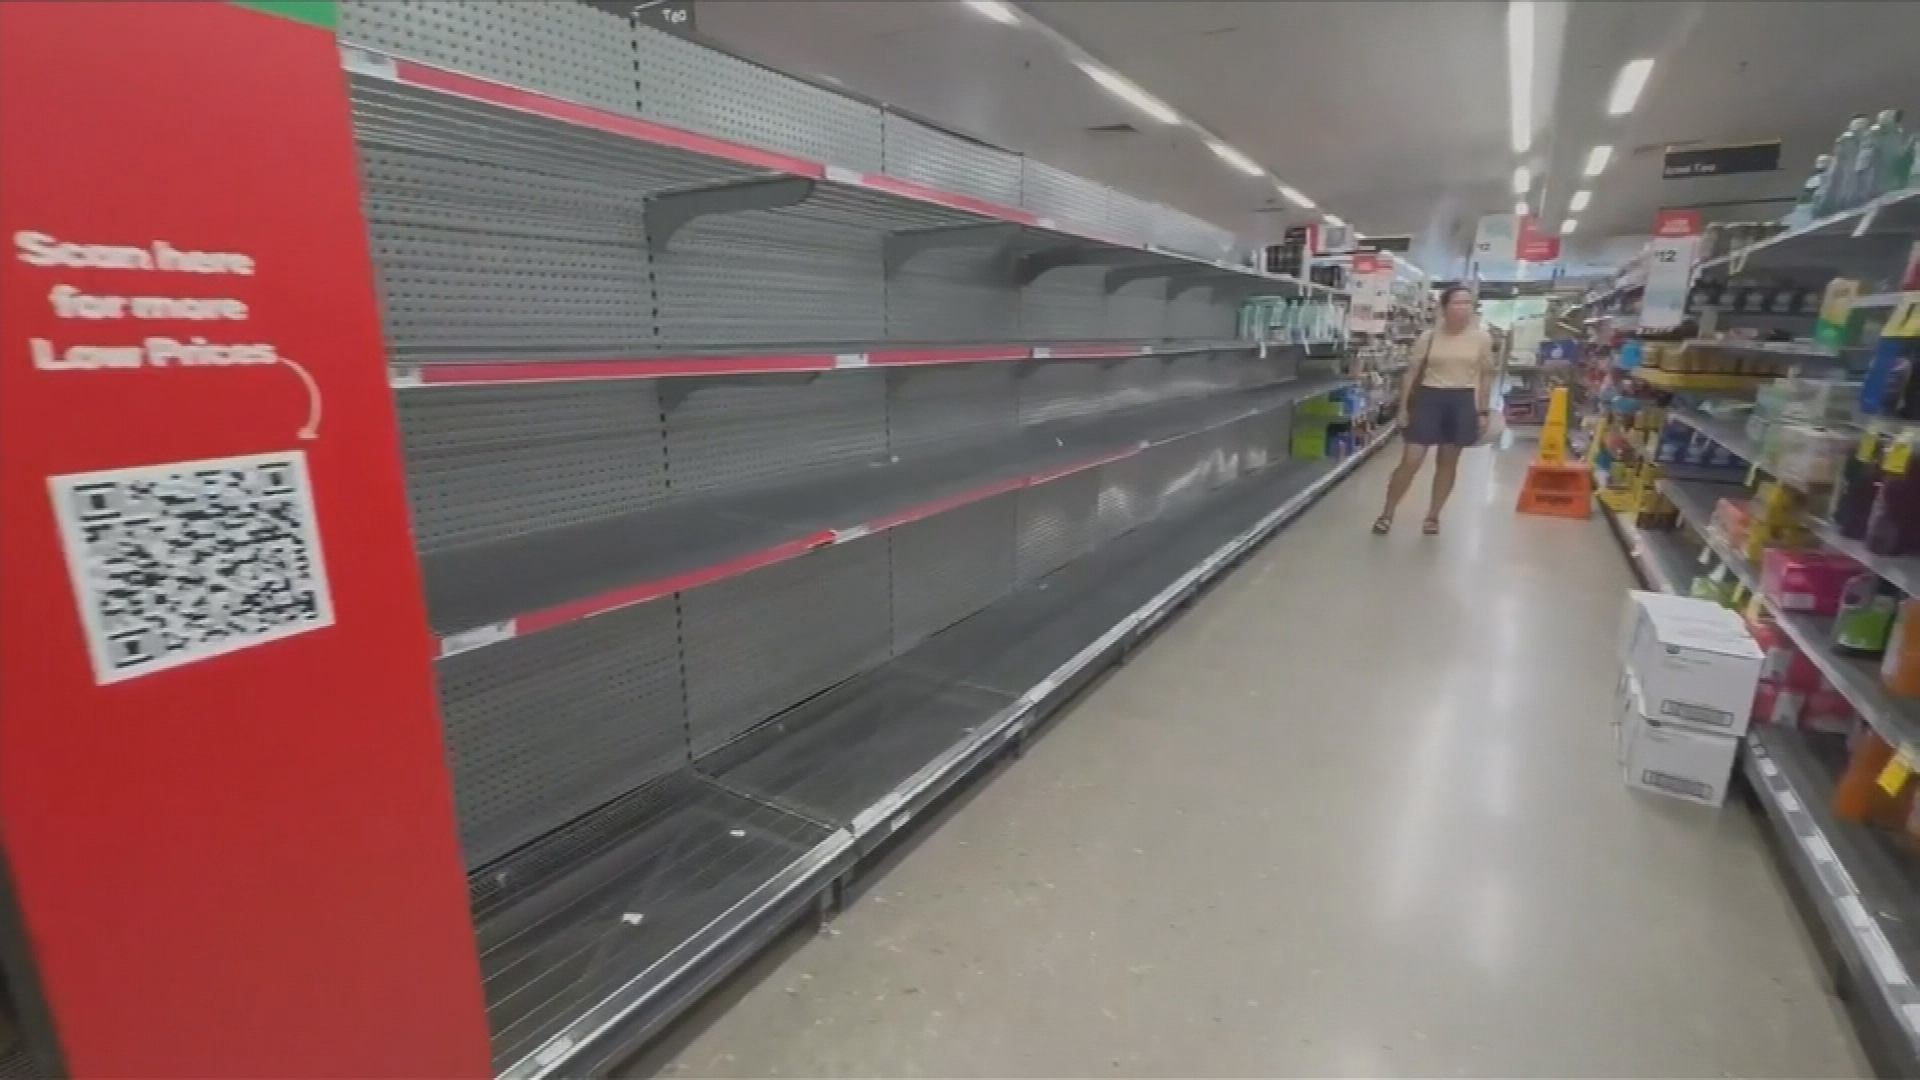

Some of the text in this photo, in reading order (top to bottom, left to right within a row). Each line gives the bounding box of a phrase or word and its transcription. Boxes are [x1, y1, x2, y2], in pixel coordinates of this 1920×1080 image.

[14, 230, 255, 275] Scan here
[48, 283, 249, 320] for more
[29, 337, 278, 370] Low Prices
